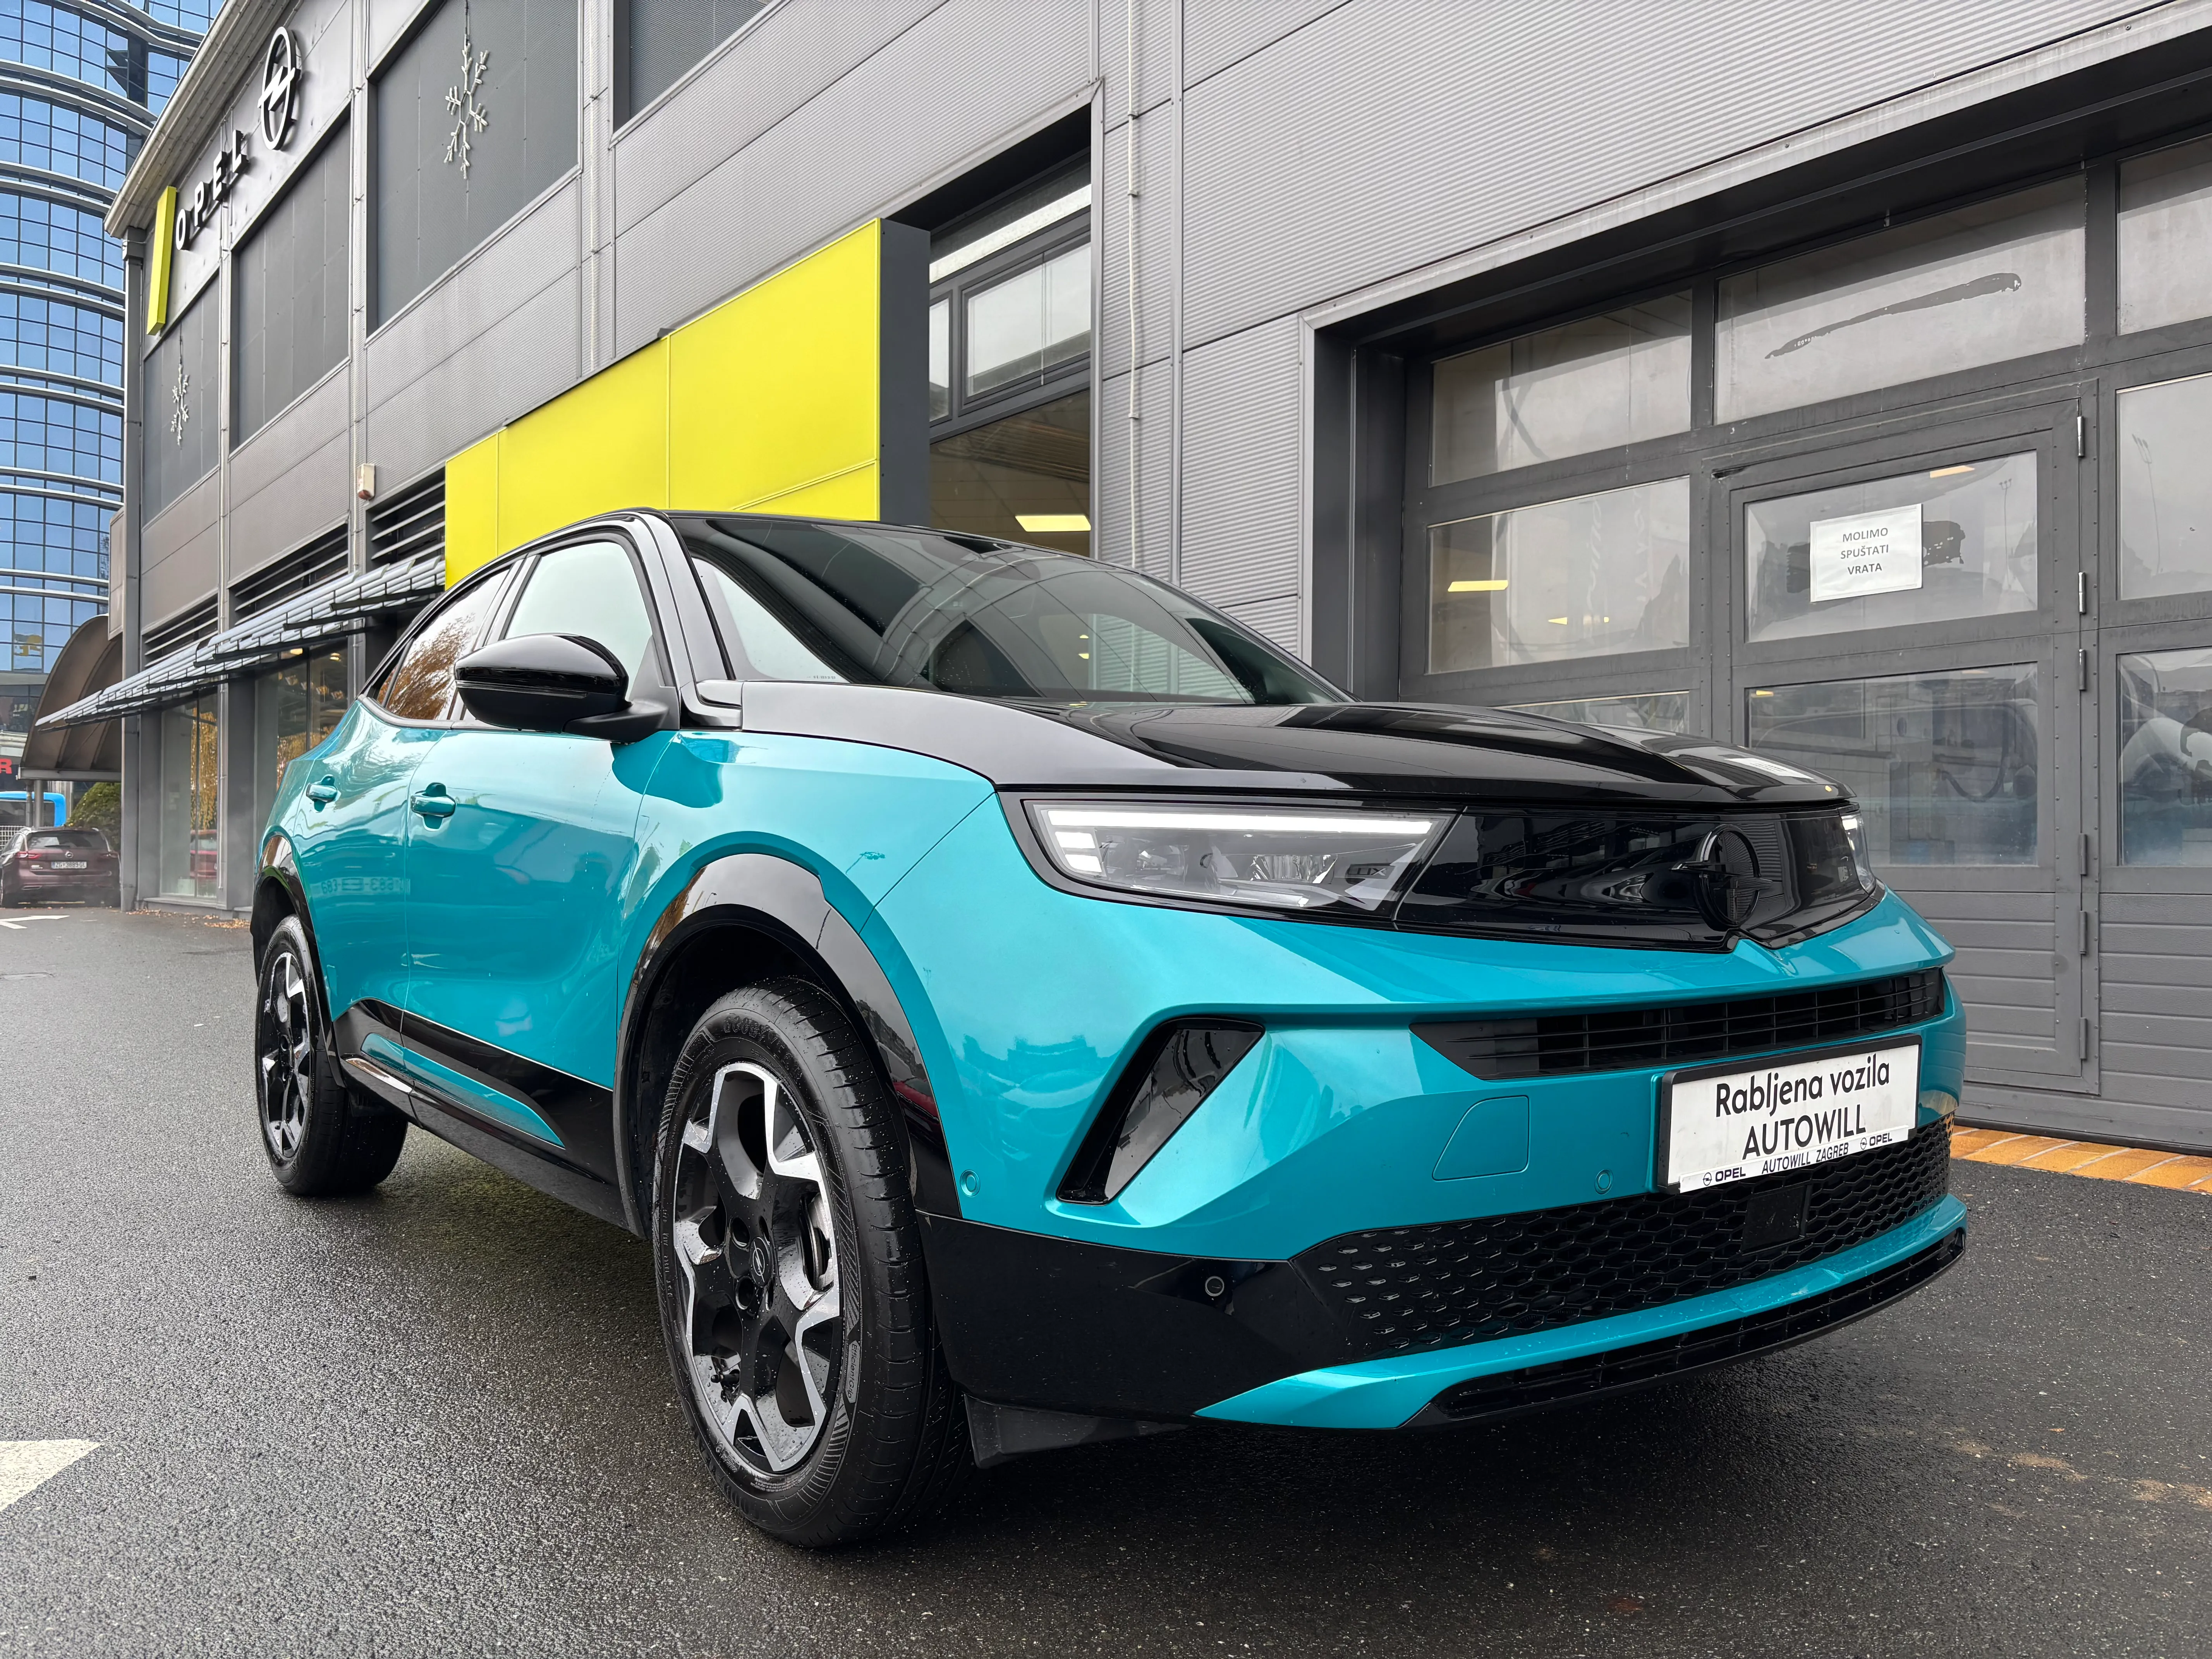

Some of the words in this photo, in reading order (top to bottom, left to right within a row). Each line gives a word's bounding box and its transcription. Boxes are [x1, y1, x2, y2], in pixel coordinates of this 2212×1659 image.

[175, 130, 249, 250] OPEL
[1840, 544, 1889, 559] SPUŠTATI
[1842, 527, 1889, 543] MOLIMO
[1847, 563, 1882, 575] VRATA
[1715, 1072, 1823, 1117] Rabljena
[1829, 1053, 1890, 1096] vozila
[1715, 1166, 1746, 1182] OPEL
[1761, 1151, 1811, 1175] AUTOWILL
[1816, 1142, 1849, 1163] ZAGREB
[1869, 1132, 1893, 1147] OPEL
[1742, 1104, 1866, 1160] AUTOWILL
